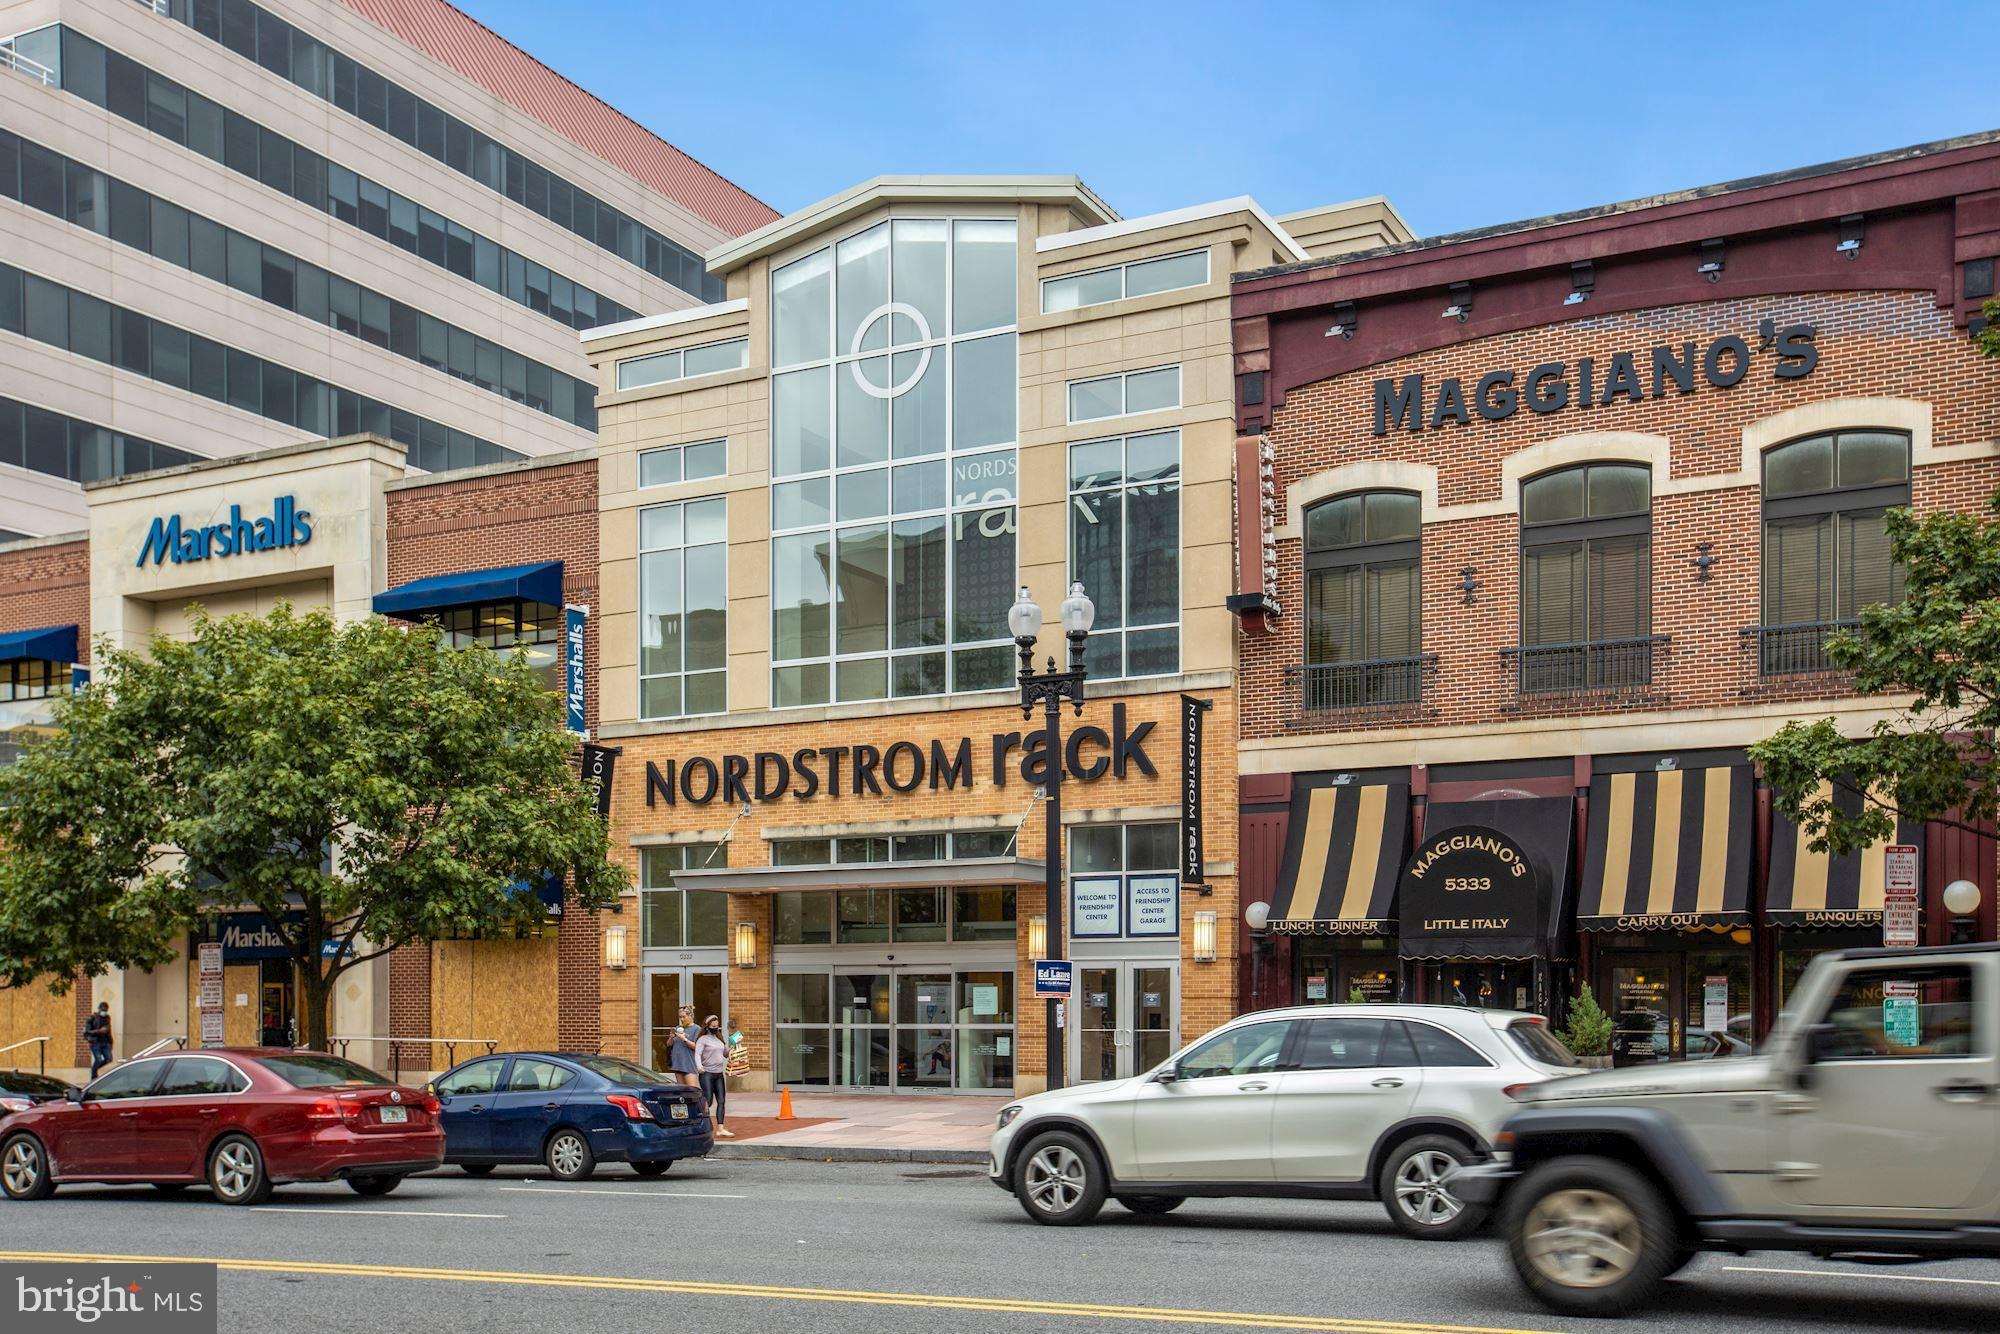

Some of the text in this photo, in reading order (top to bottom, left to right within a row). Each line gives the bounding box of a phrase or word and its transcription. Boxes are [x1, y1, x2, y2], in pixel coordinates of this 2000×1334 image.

[1373, 318, 1819, 436] MAGGIANO'S
[136, 495, 312, 568] Marshalls
[569, 623, 584, 720] Marshalls
[645, 702, 1159, 807] NORDSTROM rack
[1188, 703, 1197, 876] NORDSTROM rack
[1411, 835, 1526, 879] MAGGIANO'S
[1445, 877, 1491, 891] 5333
[1135, 897, 1171, 905] FRIENDSHIP
[1617, 914, 1701, 927] CARRY OUT
[1805, 911, 1882, 922] BANQUETS
[1272, 921, 1314, 930] LUNCH
[1330, 921, 1378, 930] DINNER
[1424, 918, 1509, 930] LITTLE ITALY
[1037, 969, 1049, 978] Ed
